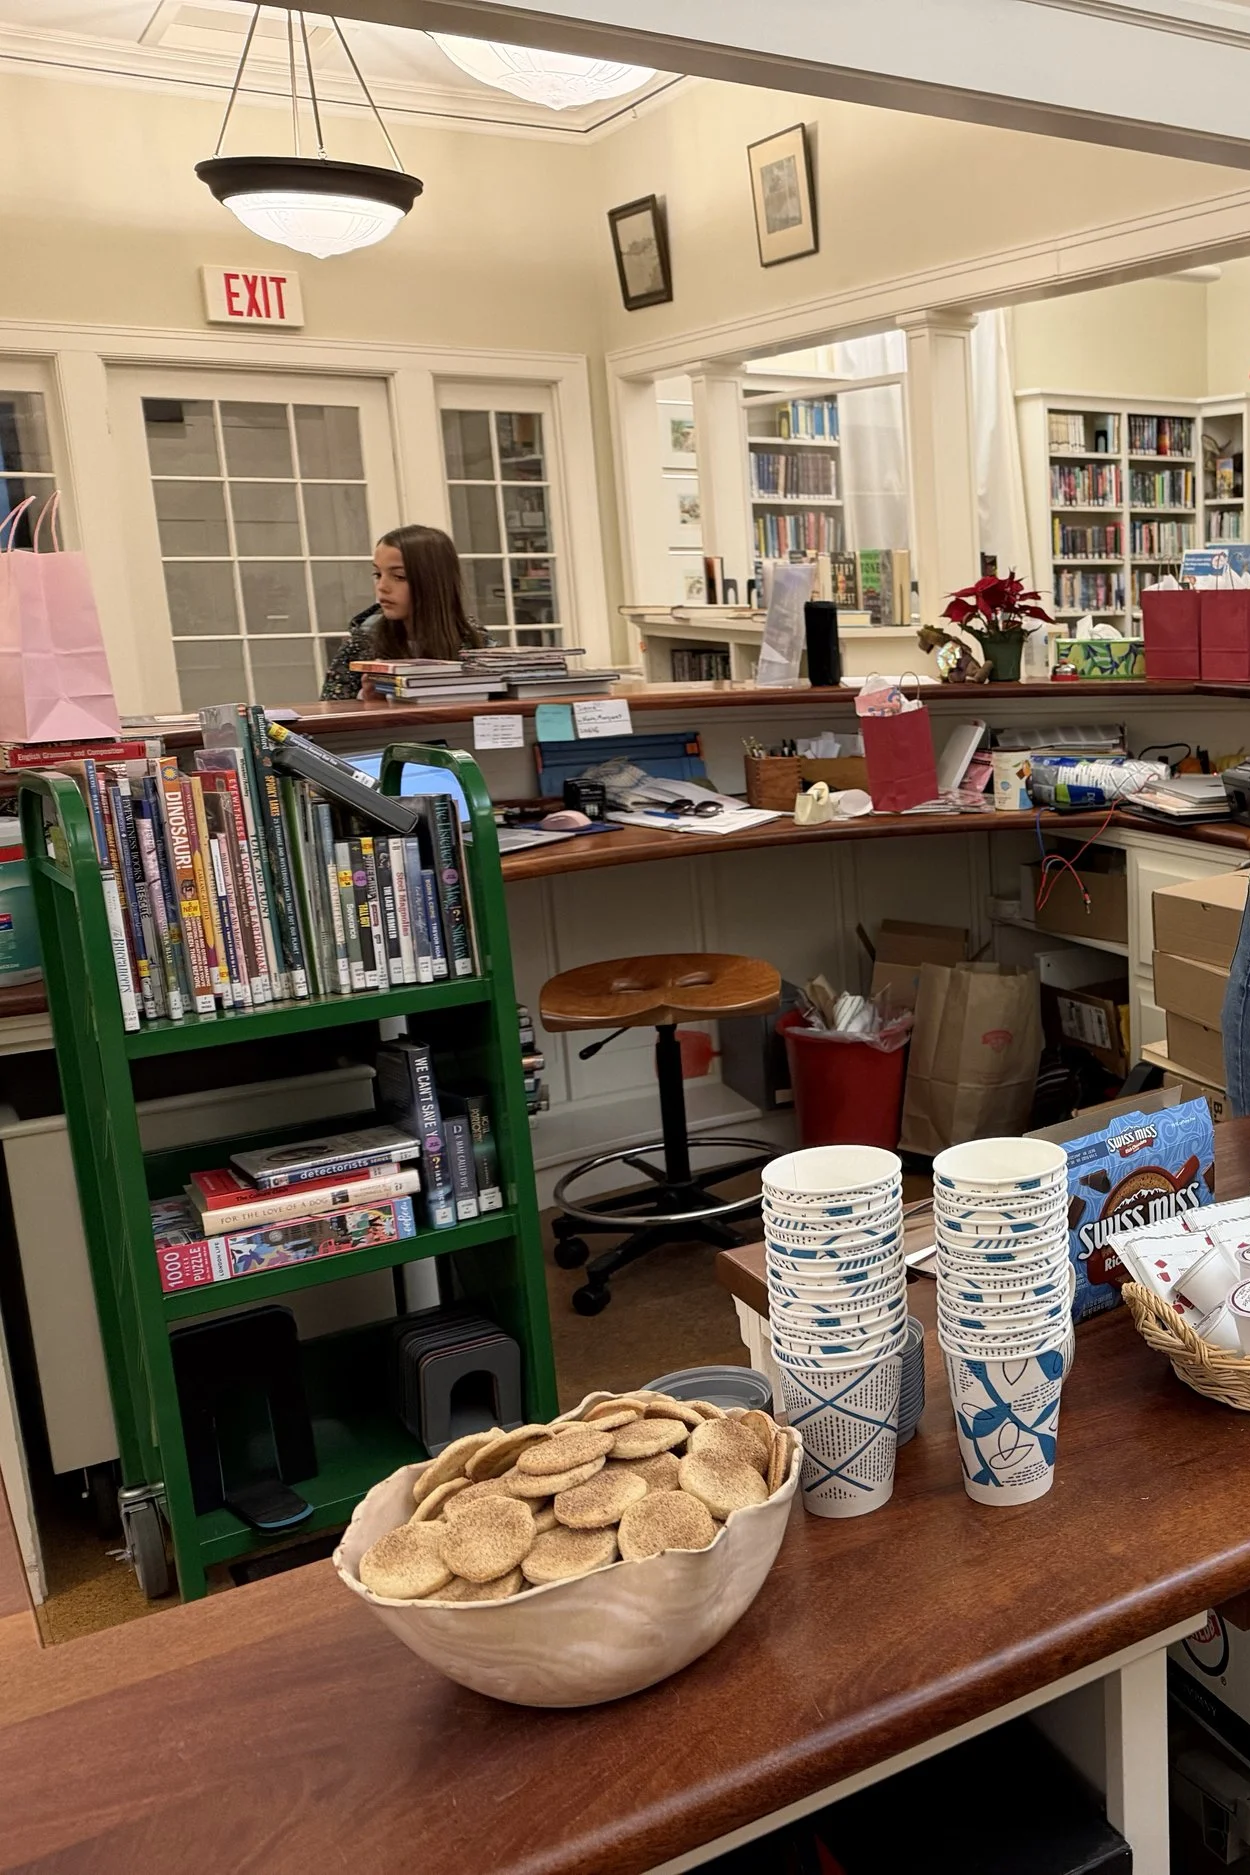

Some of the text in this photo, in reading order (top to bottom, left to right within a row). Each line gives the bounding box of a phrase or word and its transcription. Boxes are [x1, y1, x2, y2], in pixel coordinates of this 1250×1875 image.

[223, 272, 287, 320] EXIT
[257, 713, 269, 750] Rutherford
[18, 752, 41, 761] English
[42, 751, 72, 759] Grammar
[87, 748, 124, 756] Composition
[264, 775, 277, 798] SPOOKY
[268, 799, 281, 817] LAKES
[122, 799, 138, 850] EYEWITNESS
[165, 791, 192, 871] DINOSAUR!
[273, 824, 284, 846] STRANGE
[228, 778, 244, 837] EYEWITNESS
[240, 857, 256, 903] VOLCANO
[438, 819, 455, 869] Listeners
[131, 851, 144, 881] BOOKS
[279, 860, 290, 887] MYSTERIOUS
[135, 886, 150, 920] RESCUE
[259, 891, 270, 920] RUNT
[283, 886, 292, 902] LAKES
[385, 896, 395, 911] LAST
[396, 872, 410, 937] Steel Magnolias
[285, 902, 293, 915] THAT
[287, 915, 295, 925] DOT
[346, 903, 357, 939] Severance
[360, 916, 372, 928] GUY
[387, 911, 397, 939] VERMEER
[431, 922, 440, 945] TREVOR
[189, 948, 197, 965] THEM
[289, 937, 299, 955] PLANET
[113, 939, 131, 993] Buccaneers
[191, 965, 201, 989] BEFORE
[202, 965, 211, 987] AMAZING
[414, 1057, 437, 1128] WE CAN'T SAVE
[1107, 1123, 1158, 1153] SWISS MISS
[300, 1158, 369, 1180] detectorists
[456, 1140, 469, 1189] MAN CALLED OVE
[220, 1214, 238, 1224] FOR
[242, 1210, 259, 1221] THE
[263, 1206, 284, 1217] LOVE
[287, 1203, 297, 1212] OF
[310, 1197, 328, 1208] DOG
[1078, 1181, 1200, 1261] SWISS MISS
[163, 1251, 184, 1287] 1000
[189, 1247, 205, 1282] PUZZLE
[216, 1254, 225, 1277] LONDON
